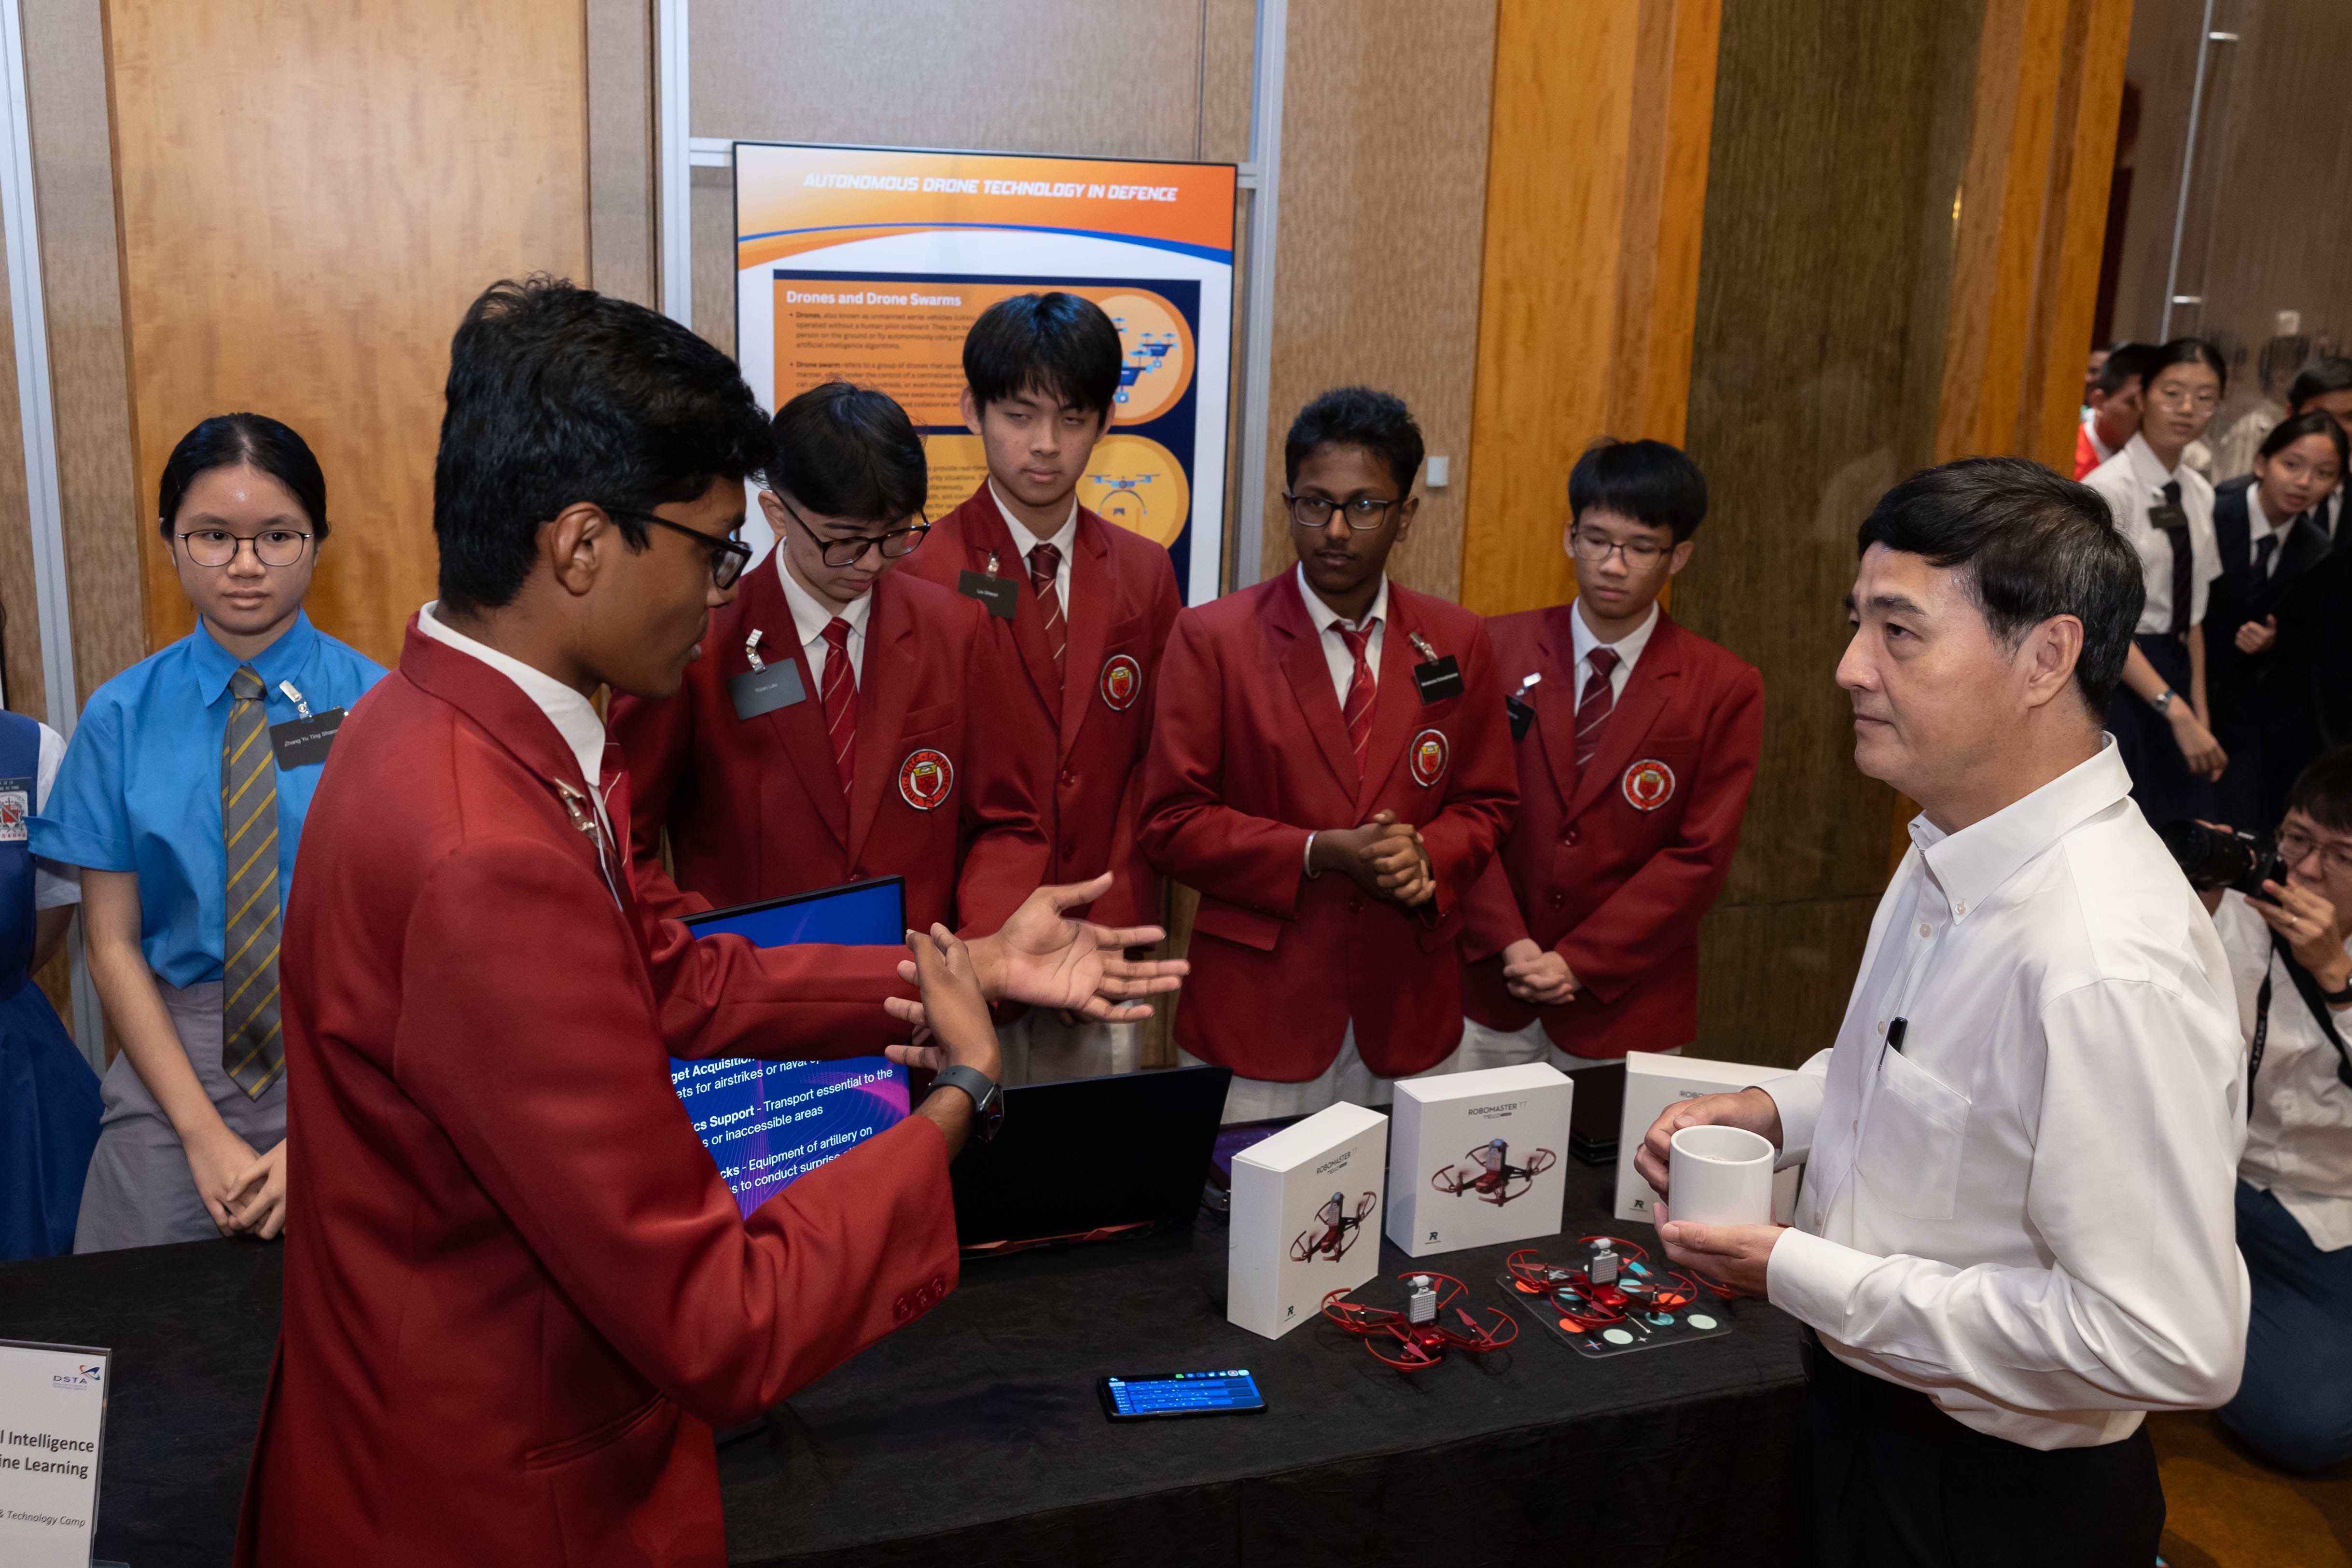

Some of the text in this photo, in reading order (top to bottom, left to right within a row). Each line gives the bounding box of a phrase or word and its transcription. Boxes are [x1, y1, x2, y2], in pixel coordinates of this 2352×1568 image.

[803, 173, 1178, 201] AUTONOMOUS DRONE TECHNOLOGY IN DEFENCE
[786, 291, 961, 306] Drones and Drone Swarms
[696, 1082, 711, 1094] for
[714, 1069, 763, 1089] airstrikes
[766, 1065, 777, 1075] or
[710, 1105, 755, 1126] Support
[764, 1089, 814, 1111] Transport
[817, 1075, 862, 1096] essential
[864, 1074, 874, 1084] to
[877, 1069, 893, 1080] the
[1468, 1103, 1517, 1116] ROBOMASTER
[711, 1135, 723, 1145] or
[726, 1114, 792, 1141] inaccessible
[794, 1106, 823, 1121] areas
[749, 1145, 804, 1171] Equipment
[807, 1141, 818, 1153] of
[820, 1130, 857, 1149] artillery
[860, 1127, 872, 1137] on
[1317, 1151, 1351, 1175] ROBOMASTER
[740, 1181, 752, 1192] to
[754, 1166, 797, 1187] conduct
[54, 1375, 87, 1384] DSTA
[9, 1431, 95, 1452] Intelligence
[25, 1457, 89, 1479] Learning
[7, 1510, 58, 1526] Technology
[60, 1516, 86, 1528] Camp
